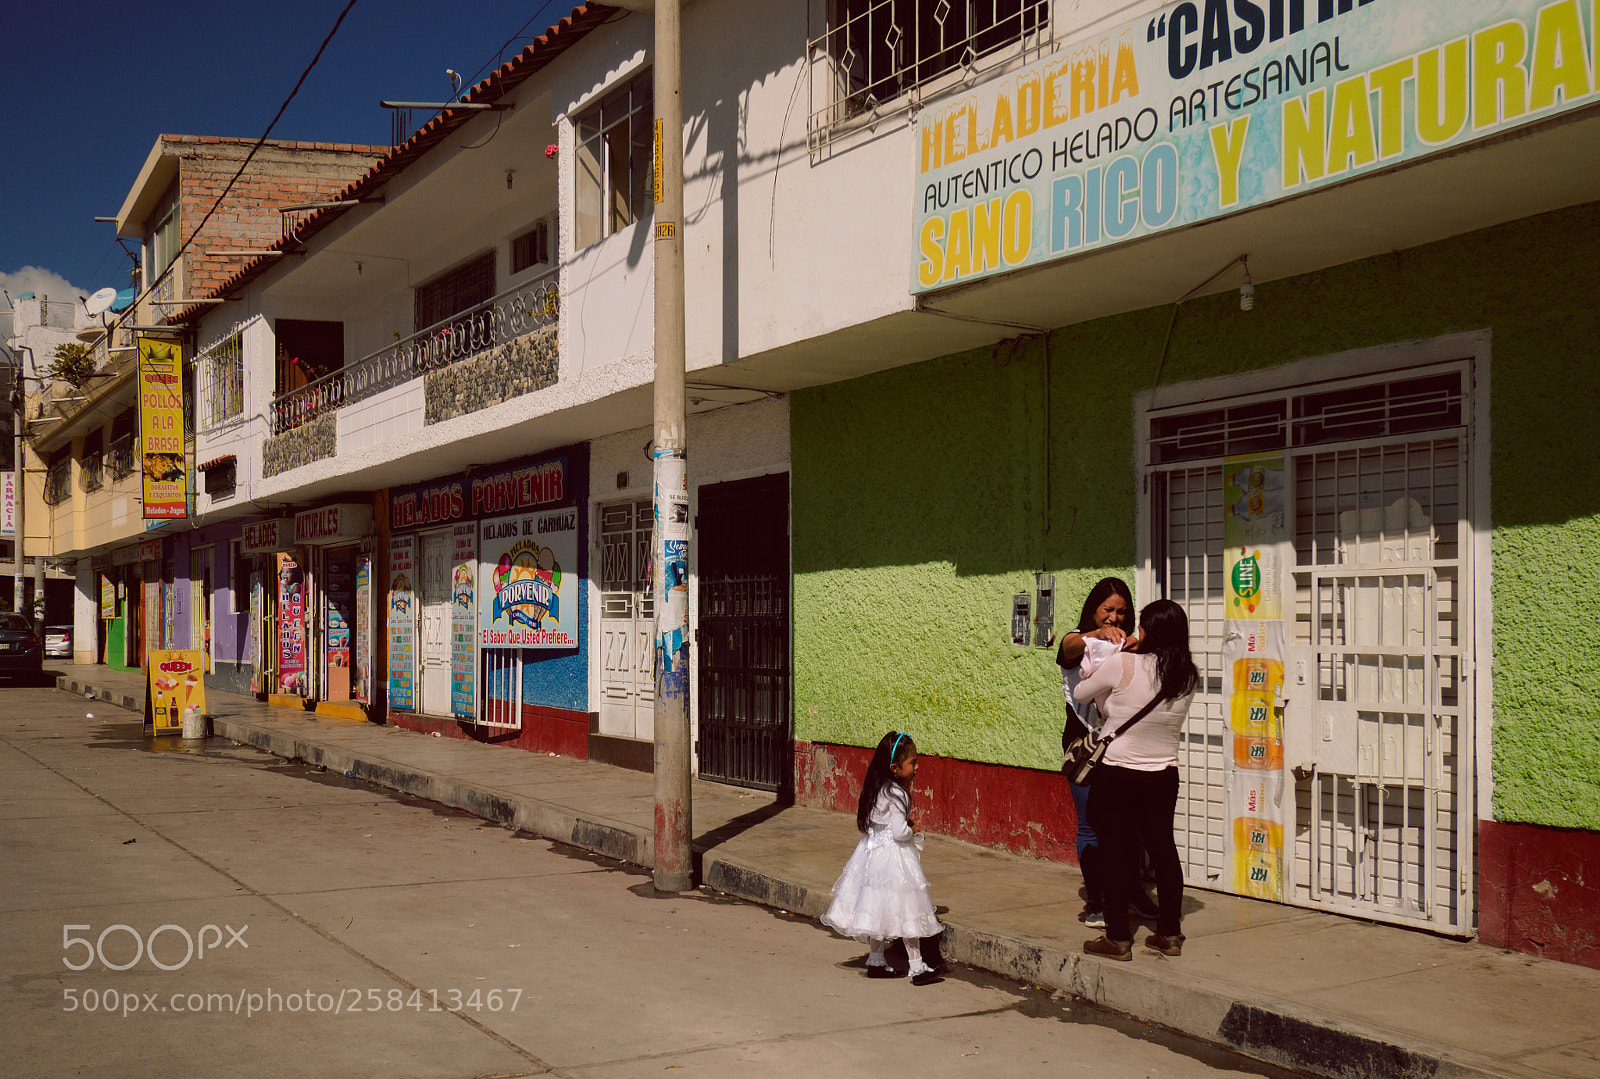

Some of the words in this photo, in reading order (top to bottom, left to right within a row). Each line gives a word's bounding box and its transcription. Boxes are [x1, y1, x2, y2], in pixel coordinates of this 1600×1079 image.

[920, 28, 1139, 174] HELADERIA
[924, 148, 1043, 213] AUTENTICO
[1052, 107, 1158, 171] HELADO
[1169, 36, 1349, 132] ARTESANAL
[918, 189, 1032, 288] SANO
[1050, 141, 1179, 255] RICO
[1209, 113, 1251, 209] Y
[1281, 0, 1600, 187] NATURA
[145, 374, 178, 384] QUEEN
[143, 393, 182, 409] POLLOS
[152, 415, 159, 430] A
[161, 415, 174, 430] LA
[148, 436, 180, 451] BRASA
[5, 473, 14, 528] FARMACIA
[393, 483, 464, 529] HELADOS
[471, 460, 565, 516] PORVENIR
[244, 522, 277, 550] HELADOS
[295, 508, 339, 542] NATURALES
[483, 519, 518, 540] HELADOS
[522, 516, 534, 536] DE
[537, 511, 576, 534] CARHUAZ
[510, 539, 541, 557] HELADOS
[1239, 559, 1253, 596] SLINE
[501, 582, 550, 609] PORVENIR
[282, 592, 291, 658] HELADOS
[292, 593, 301, 653] QUEEN
[483, 629, 489, 644] El
[490, 629, 507, 644] Sabor
[508, 629, 520, 645] Que
[521, 629, 540, 645] Usted
[541, 629, 574, 645] Prefiere...
[1247, 633, 1256, 652] Má
[160, 661, 193, 673] QUEEN
[1250, 707, 1268, 720] KR
[1248, 789, 1256, 812] Más
